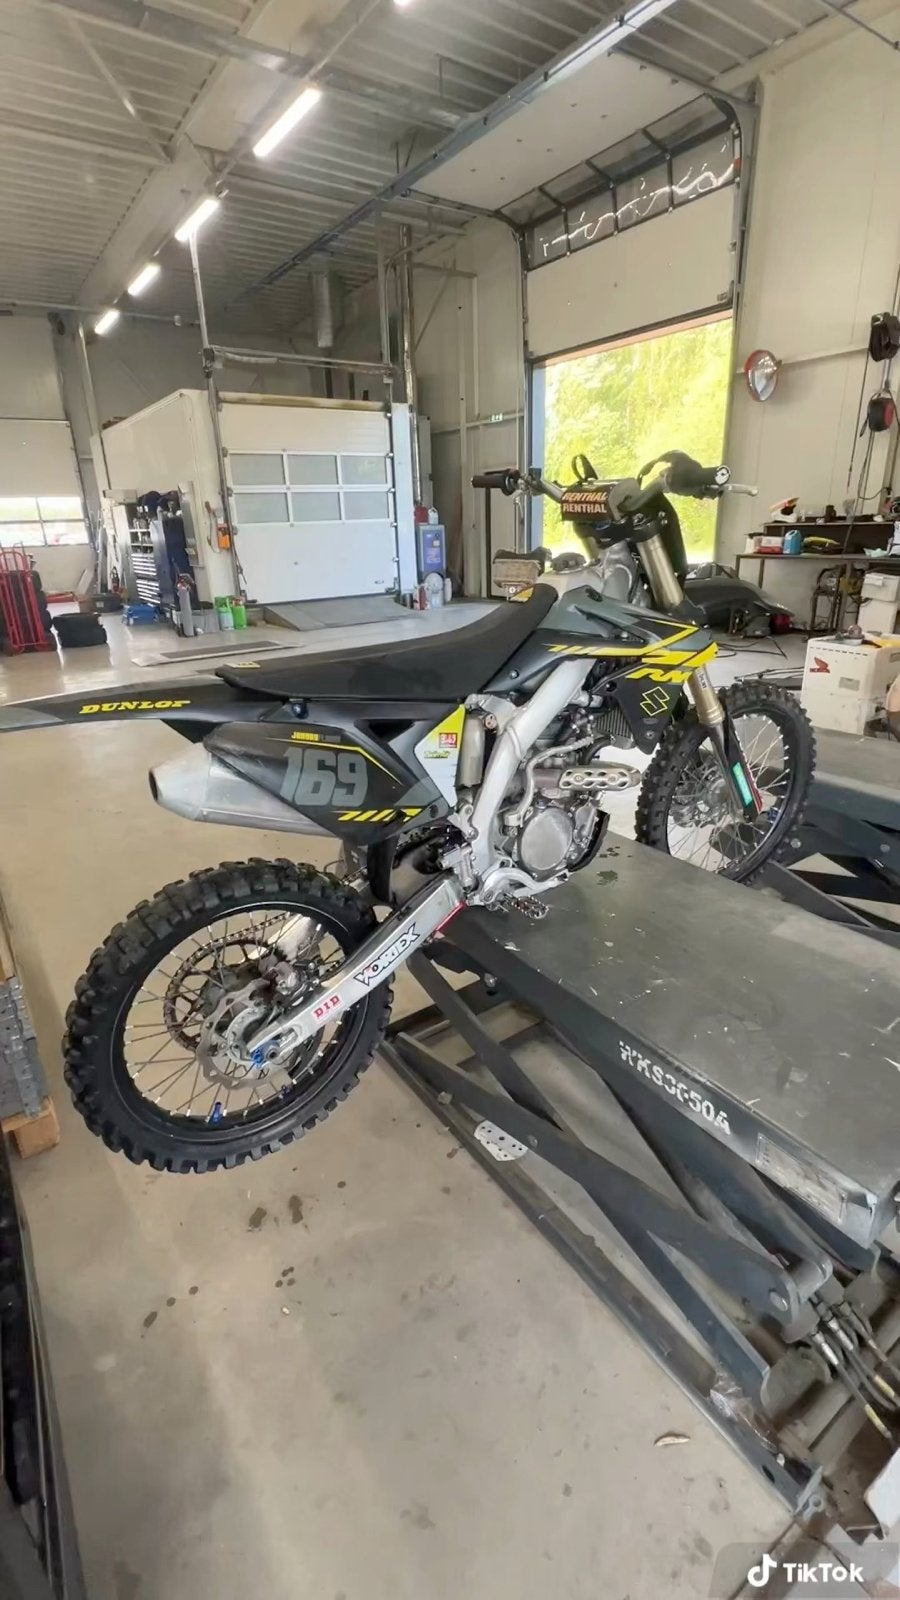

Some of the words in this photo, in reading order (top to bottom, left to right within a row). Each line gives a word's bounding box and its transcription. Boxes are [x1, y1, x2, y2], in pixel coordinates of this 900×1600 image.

[562, 502, 608, 513] RENTHAL
[79, 700, 191, 714] DUNLOP
[279, 747, 369, 807] 169
[353, 922, 420, 987] VORTEX
[314, 995, 341, 1018] DID
